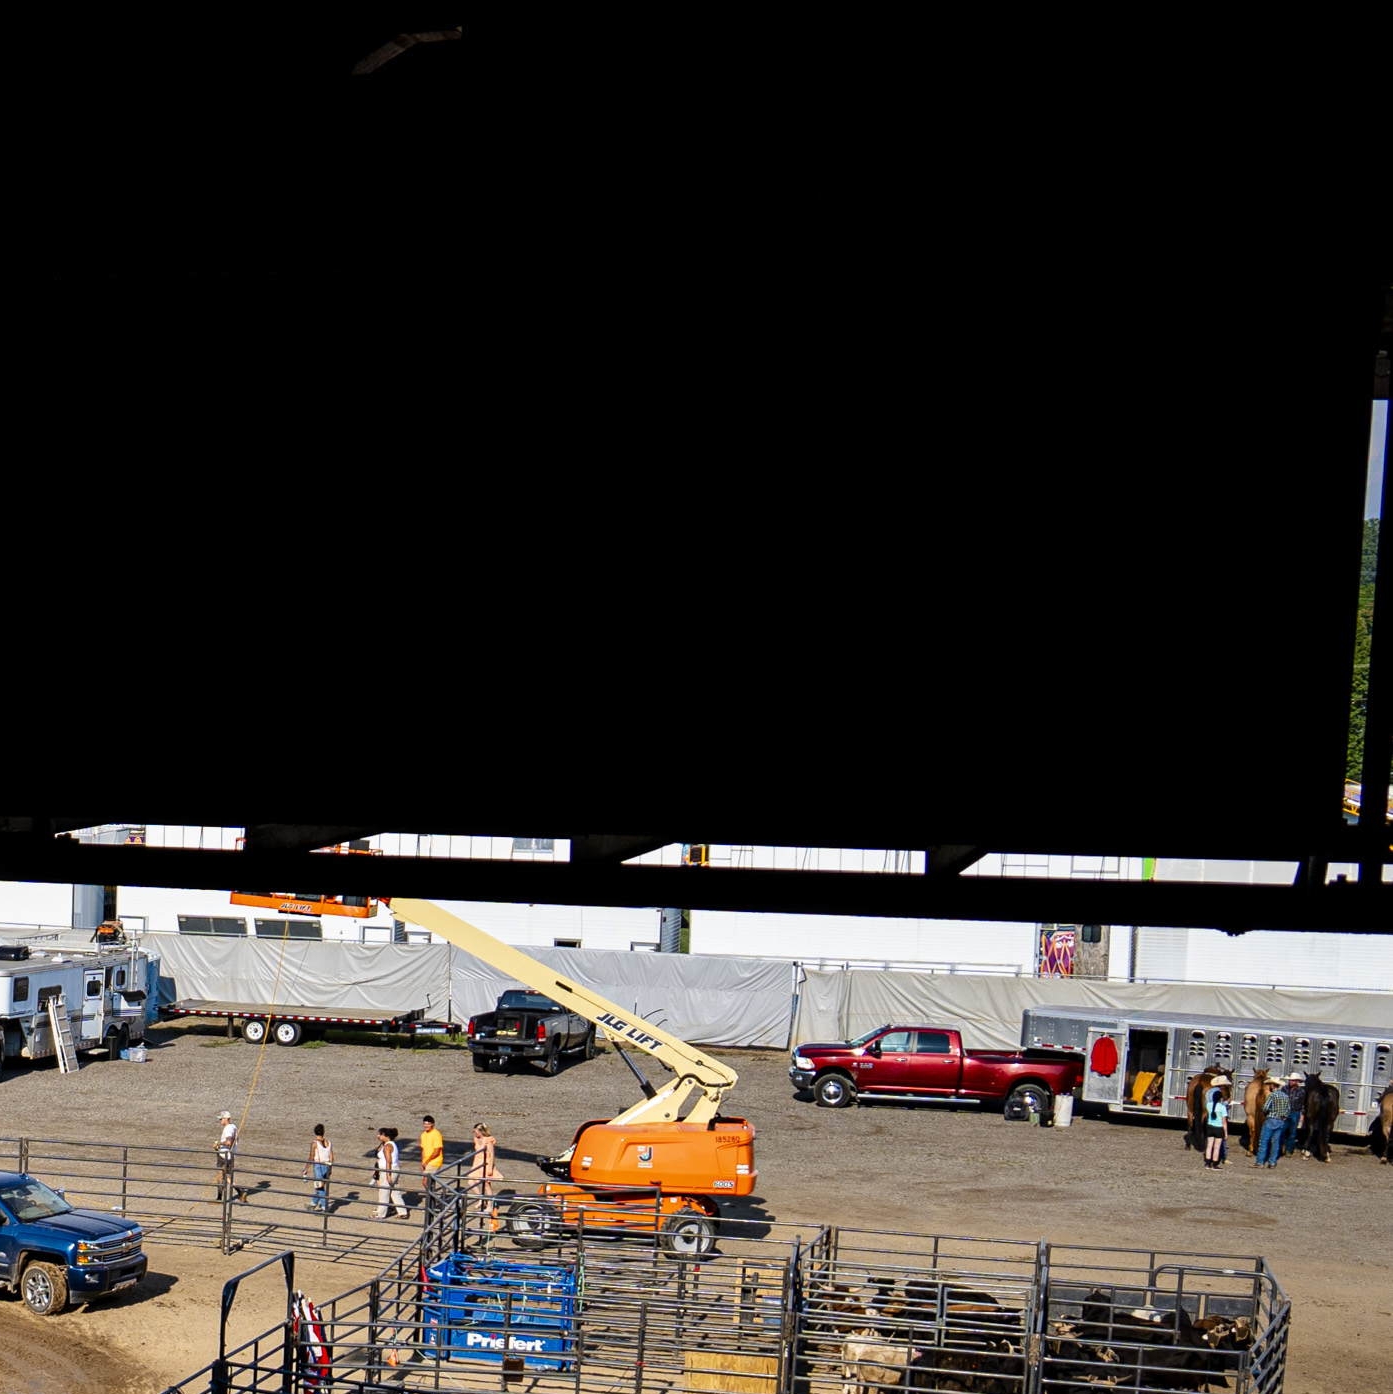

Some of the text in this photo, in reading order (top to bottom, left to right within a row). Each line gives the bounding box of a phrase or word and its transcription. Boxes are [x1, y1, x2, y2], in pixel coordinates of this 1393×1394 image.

[596, 1012, 663, 1050] JLG LIFT
[713, 1180, 734, 1188] 600S
[466, 1332, 545, 1350] Priefert
